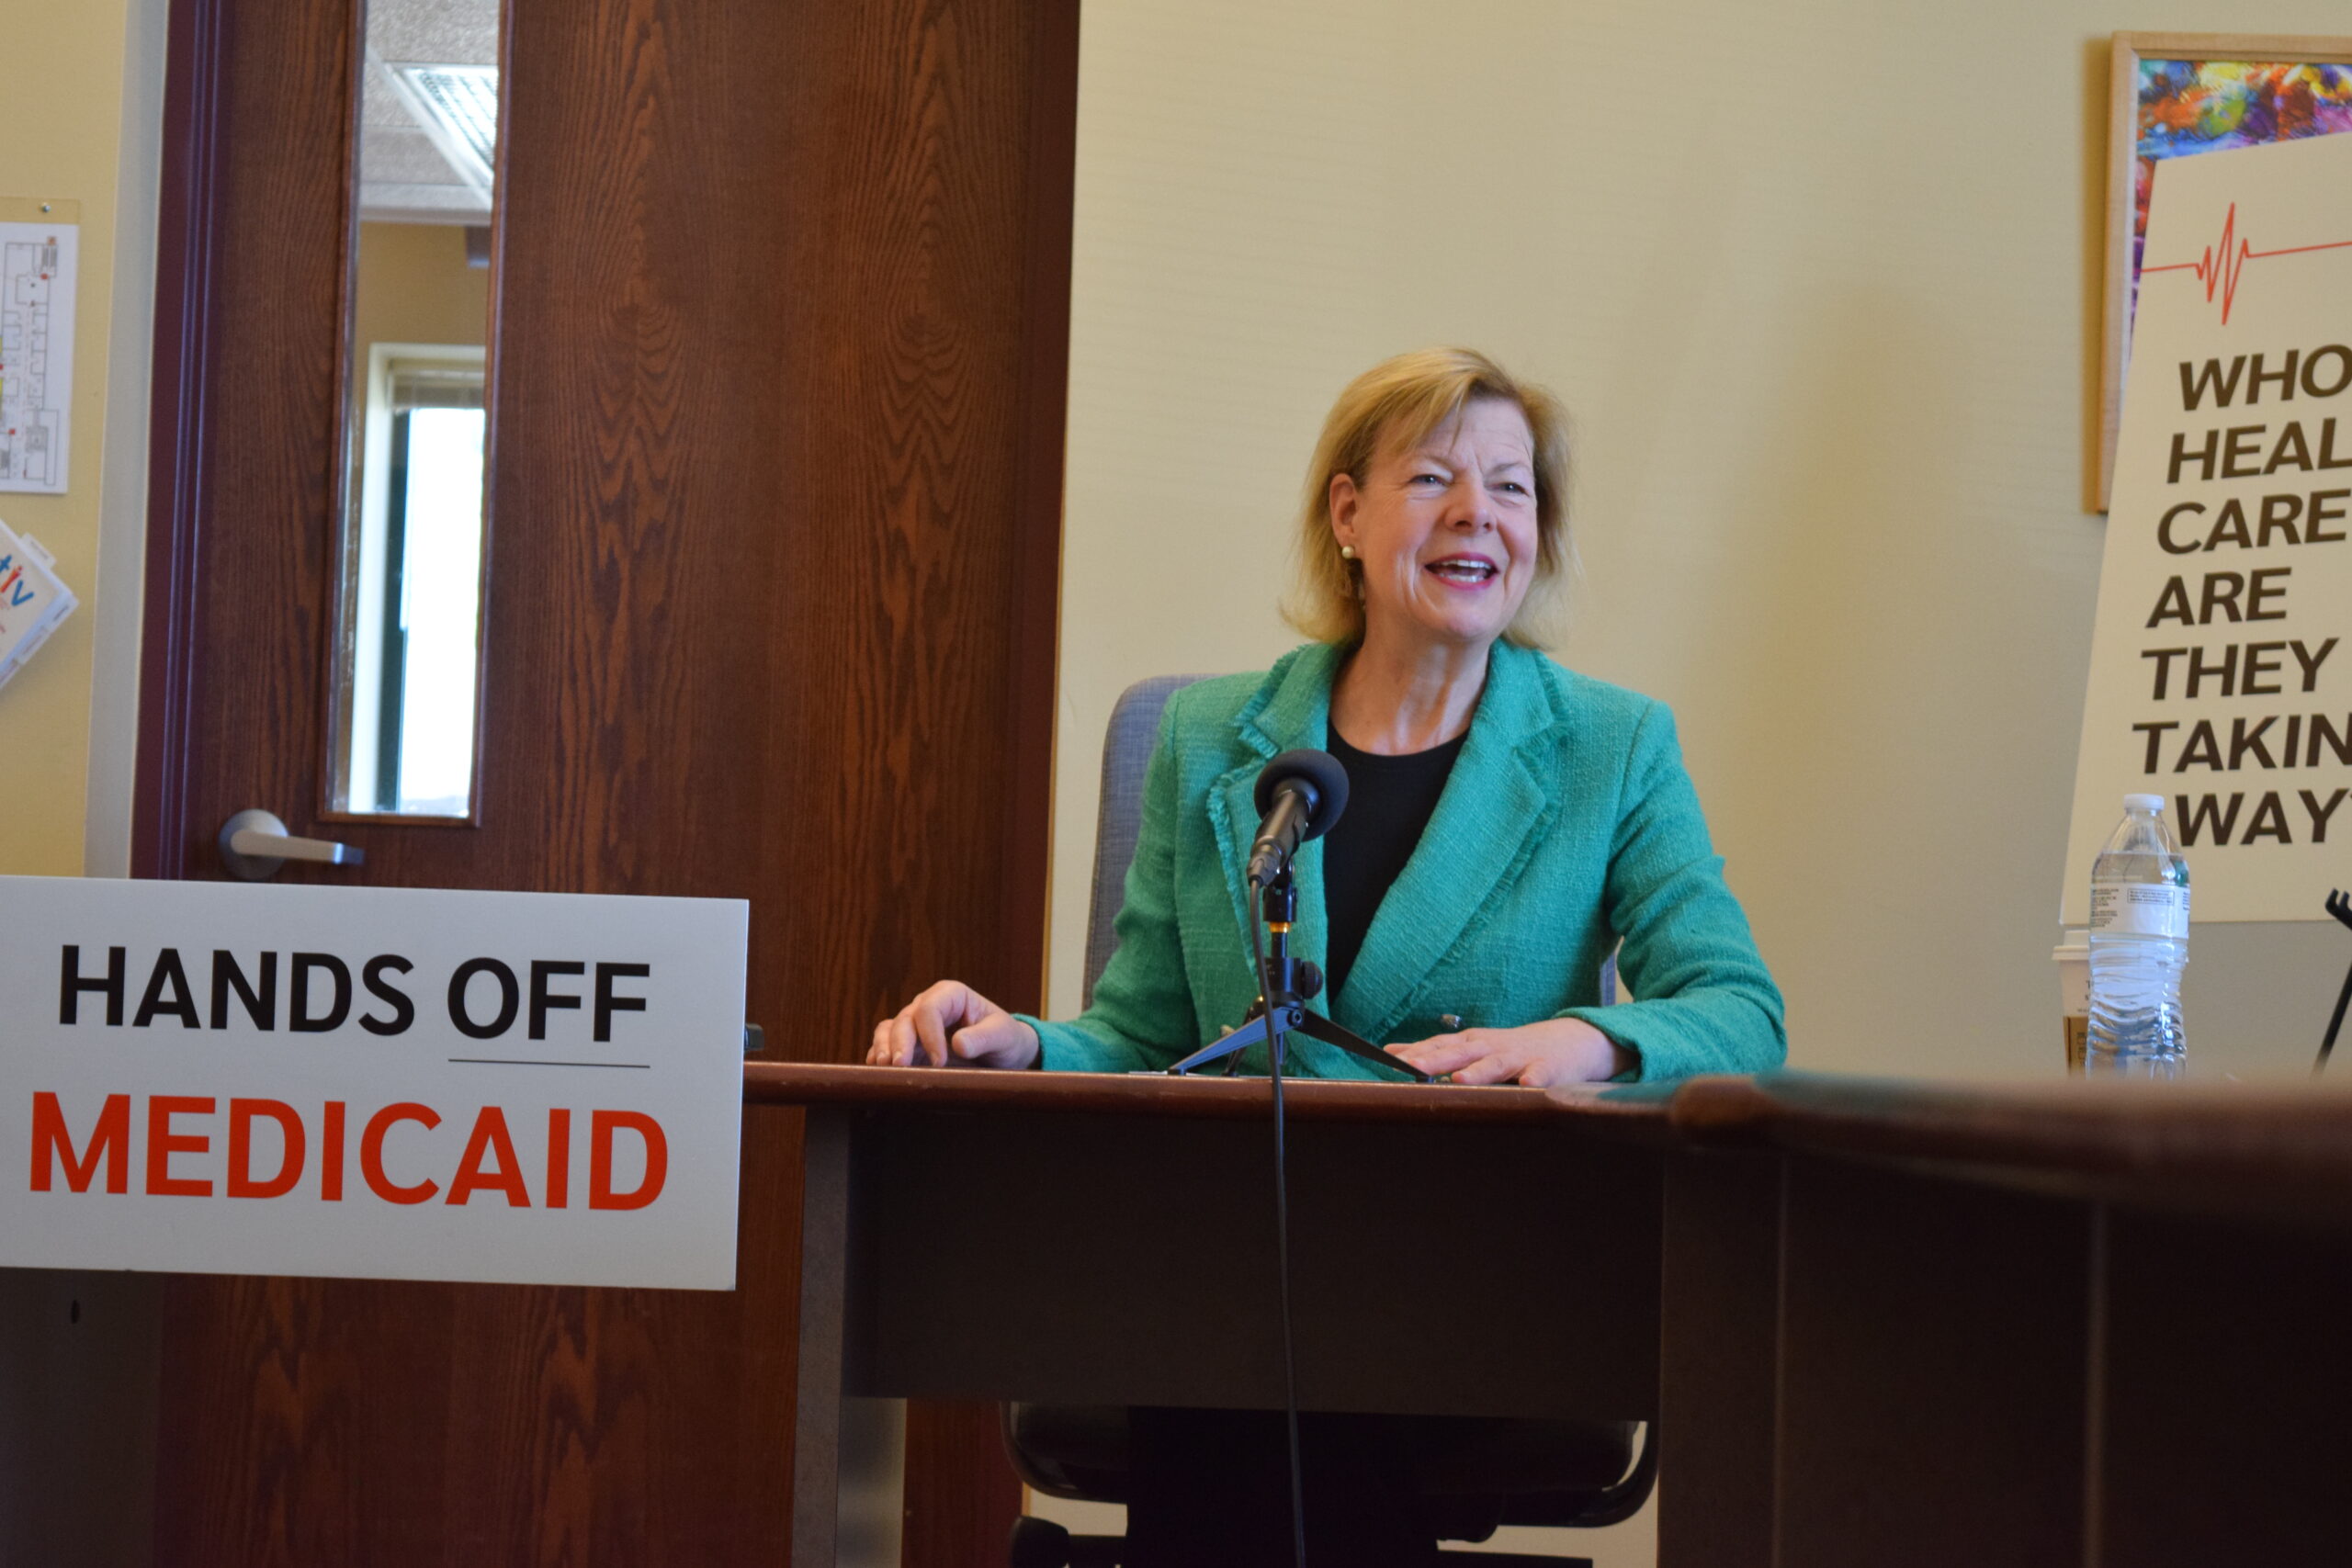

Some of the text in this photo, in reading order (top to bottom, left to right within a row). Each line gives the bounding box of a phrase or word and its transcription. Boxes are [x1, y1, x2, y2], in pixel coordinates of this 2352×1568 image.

[2178, 344, 2352, 412] WHO
[2166, 417, 2352, 484] HEAL
[2156, 488, 2352, 556] CARE
[2145, 567, 2292, 628] ARE
[2141, 637, 2340, 701] THEY
[2132, 712, 2352, 774] TAKIN
[2175, 787, 2352, 848] WAY
[59, 944, 650, 1043] HANDS OFF
[29, 1091, 668, 1211] MEDICAID
